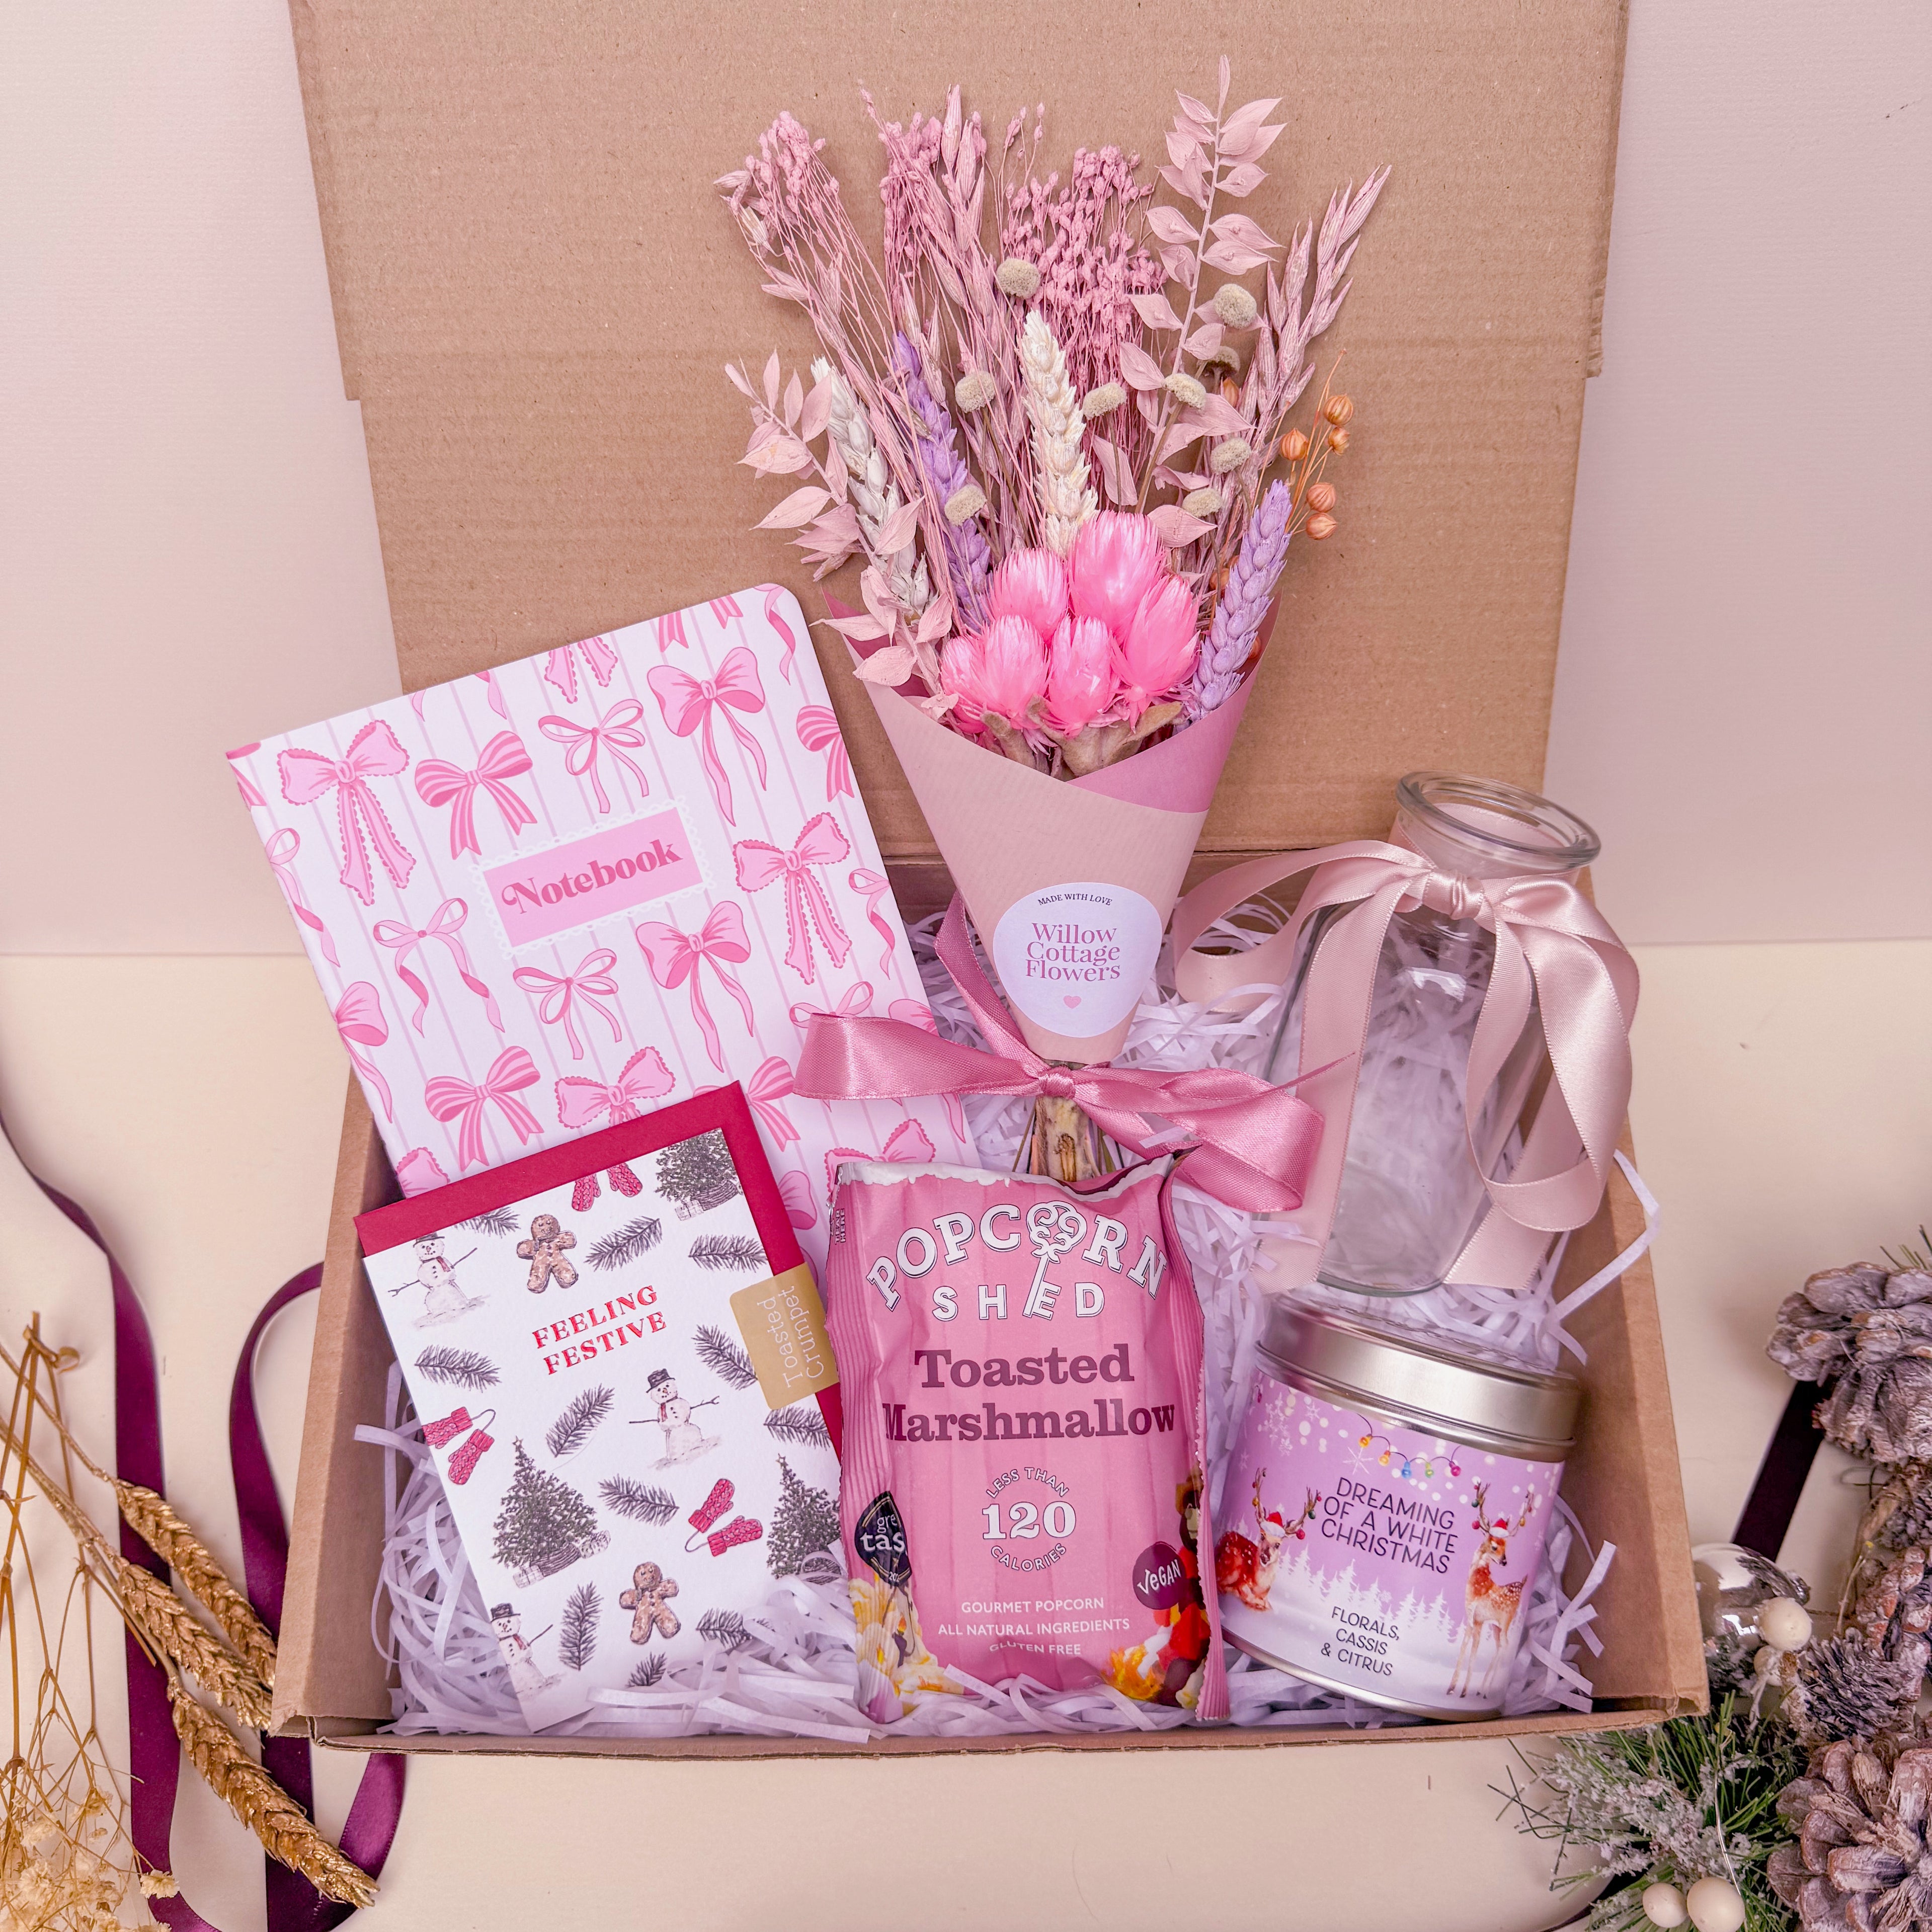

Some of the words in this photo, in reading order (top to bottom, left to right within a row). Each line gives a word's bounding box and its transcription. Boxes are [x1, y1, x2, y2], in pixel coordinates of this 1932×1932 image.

[501, 839, 683, 914] Notebook
[1037, 894, 1063, 906] MADE
[1089, 895, 1112, 906] LOVE
[1031, 922, 1117, 944] Willow
[1025, 959, 1120, 982] Flowers
[1027, 941, 1120, 967] Cottage
[532, 1285, 658, 1349] FEELING
[932, 1281, 1105, 1322] SHED
[543, 1311, 667, 1375] FESTIVE
[757, 1296, 803, 1388] Toasted
[778, 1285, 824, 1378] Crumpet
[914, 1343, 1135, 1388] Toasted
[882, 1398, 1175, 1442] Marshmallow
[986, 1469, 1020, 1499] LESS
[1024, 1467, 1070, 1497] THAN
[982, 1500, 1077, 1540] 120
[1336, 1477, 1455, 1530] DREAMING
[1323, 1496, 1354, 1519] OF
[1360, 1510, 1375, 1531] A
[1388, 1516, 1459, 1554] WHITE
[991, 1543, 1067, 1572] CALORIES
[1321, 1518, 1450, 1574] CHRISTMAS
[961, 1600, 1031, 1613] GOURMET
[1035, 1597, 1105, 1613] POPCORN
[1331, 1605, 1400, 1641] FLORALS,
[938, 1624, 963, 1635] ALL
[967, 1624, 1033, 1636] NATURAL
[1036, 1618, 1130, 1635] INGREDIENTS
[1336, 1628, 1388, 1655] CASSIS
[989, 1640, 1044, 1653] GLUTEN
[1049, 1644, 1081, 1655] FREE
[1321, 1642, 1331, 1657] &
[1337, 1648, 1393, 1676] CITRUS
